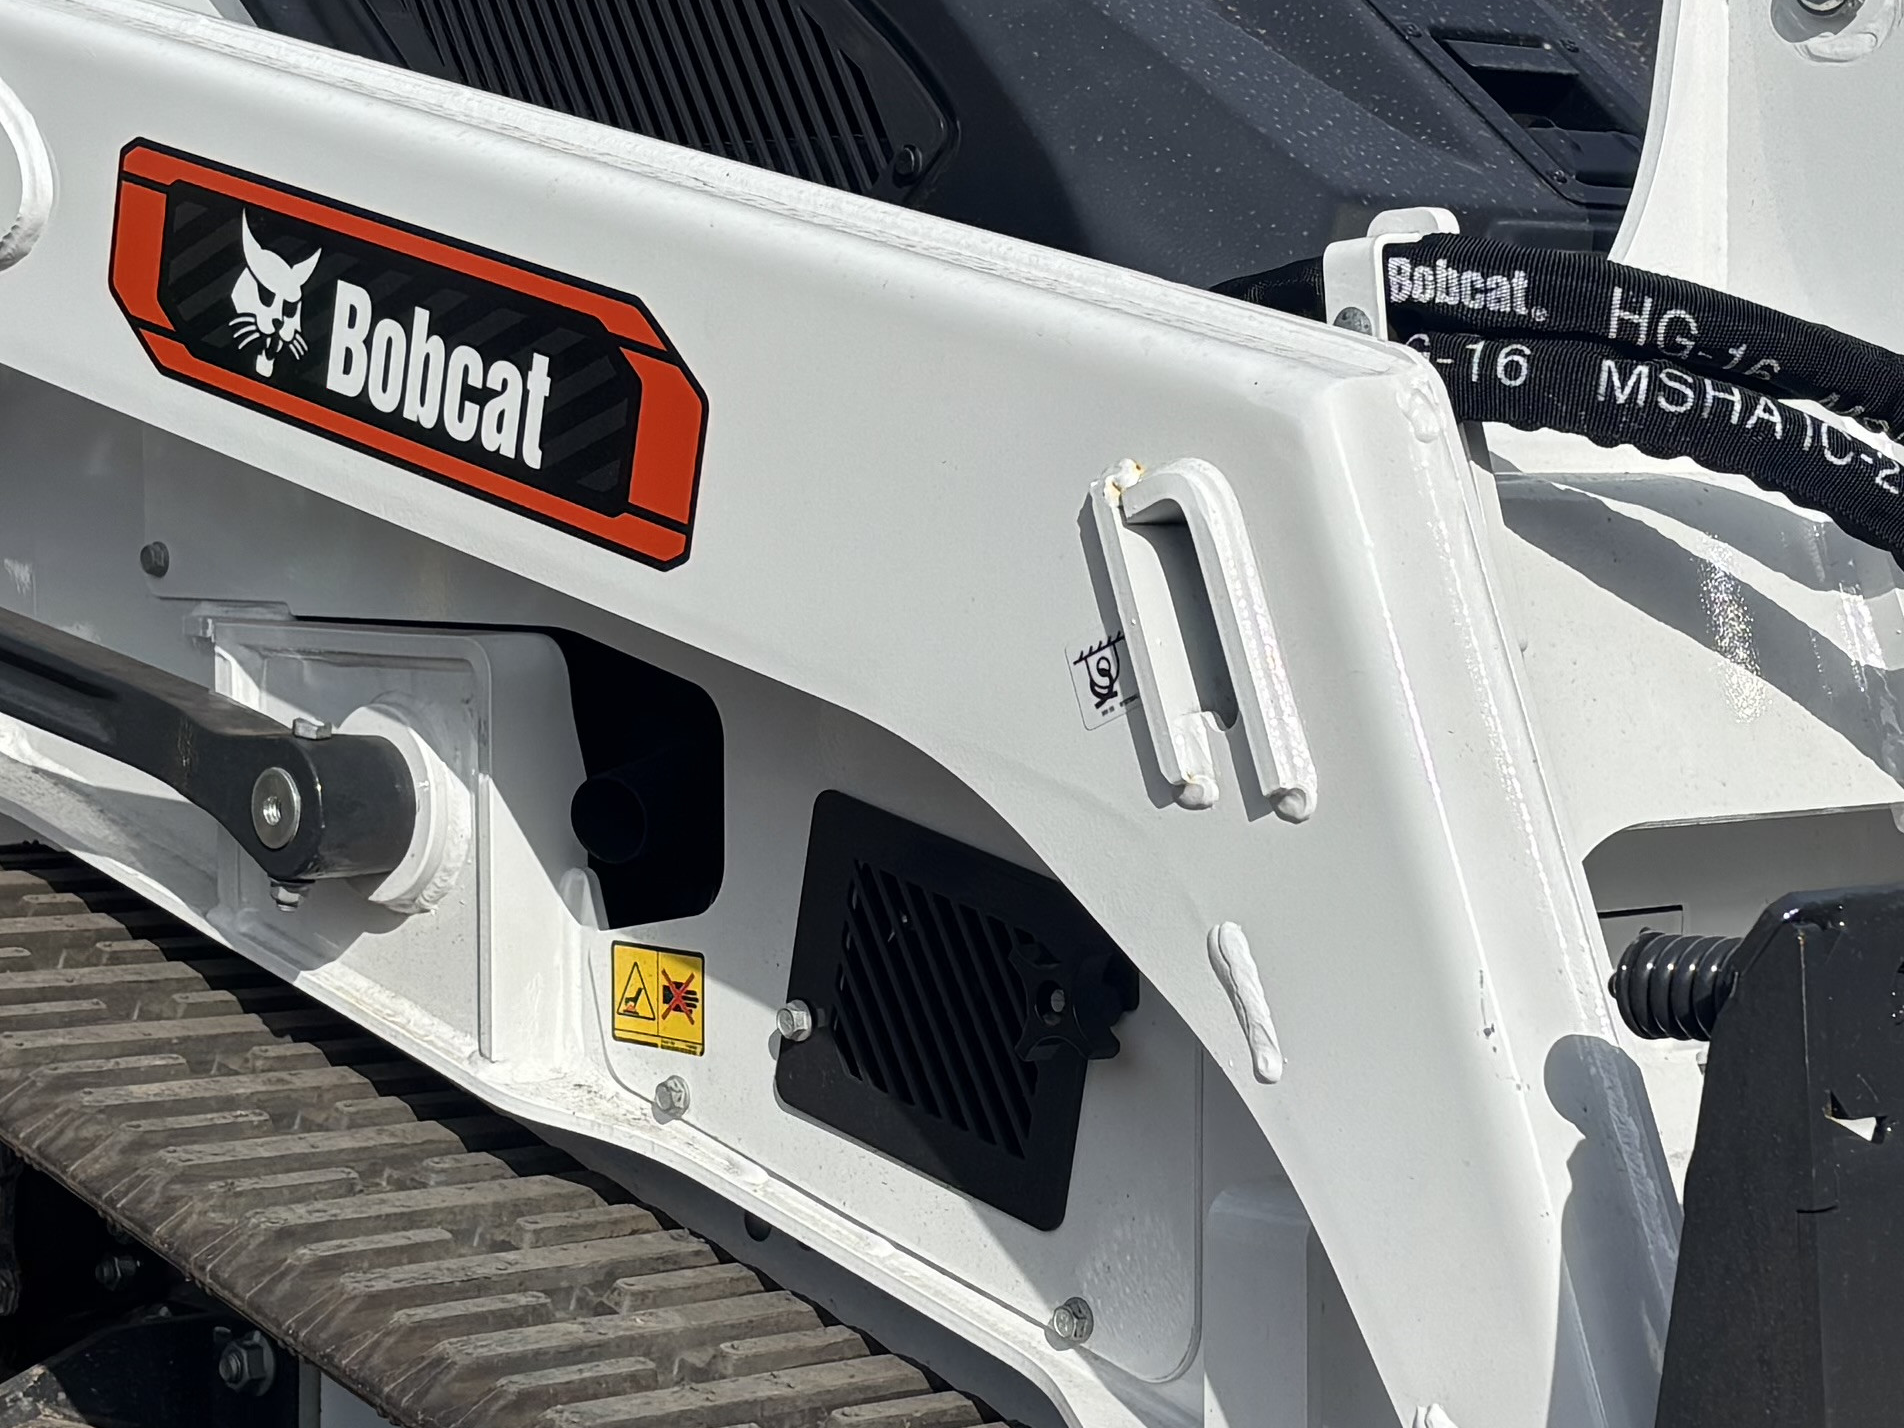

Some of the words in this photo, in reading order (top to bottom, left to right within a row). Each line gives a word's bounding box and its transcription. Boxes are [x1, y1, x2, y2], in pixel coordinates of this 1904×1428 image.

[1388, 256, 1529, 316] Bobcat
[327, 279, 551, 469] Bobcat
[1596, 359, 1783, 440] MSHA
